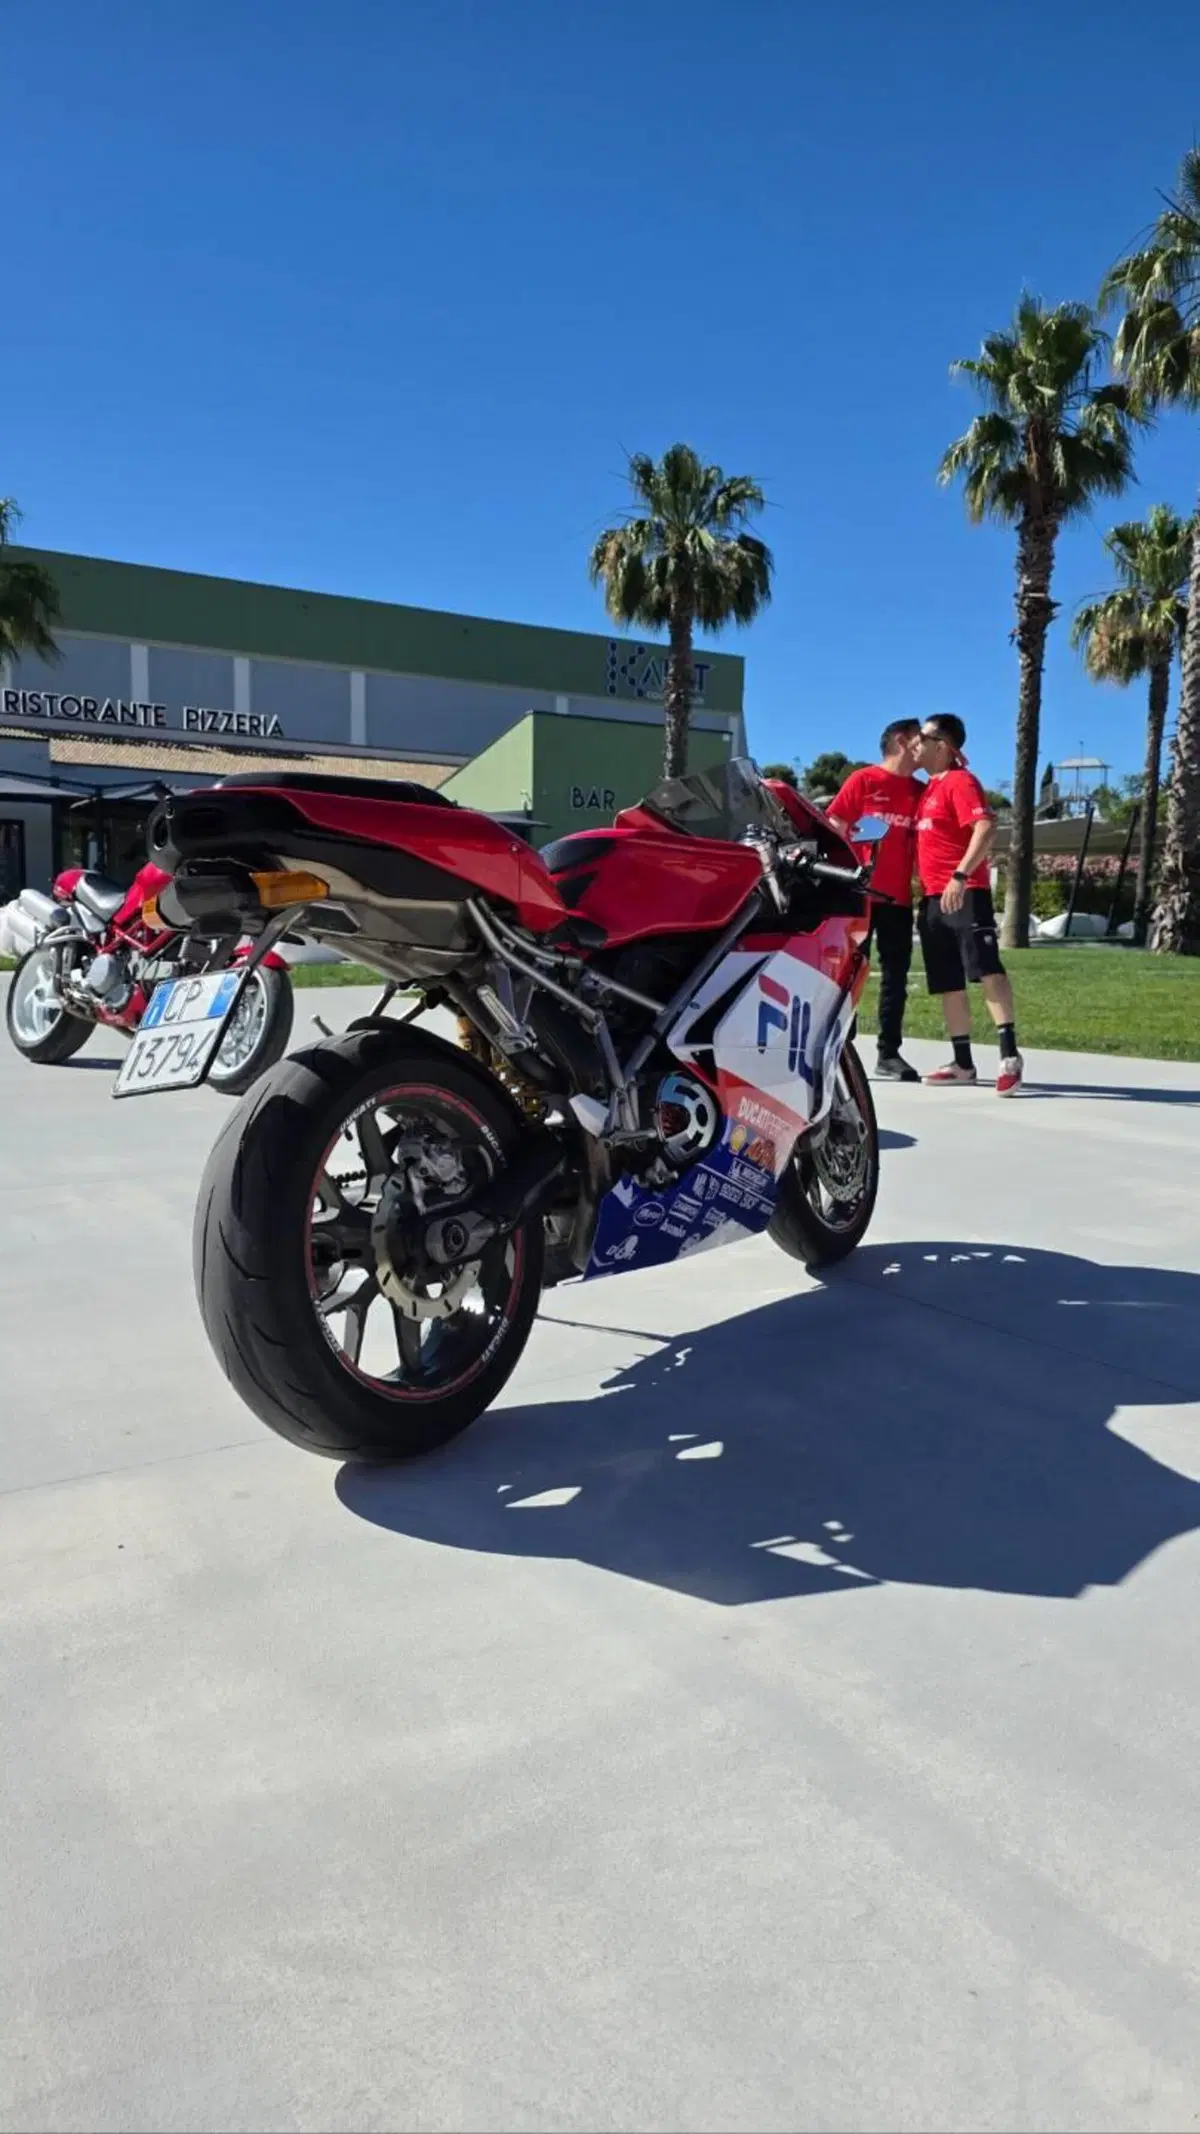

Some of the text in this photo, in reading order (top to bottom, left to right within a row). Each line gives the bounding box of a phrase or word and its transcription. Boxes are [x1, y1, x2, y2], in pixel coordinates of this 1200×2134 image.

[608, 641, 712, 698] KAT
[2, 688, 285, 738] RISTORANTE PIZZERIA
[571, 785, 616, 812] BAR
[163, 979, 205, 1022] CP
[126, 1028, 217, 1081] 13794
[480, 1125, 508, 1169] DUCA
